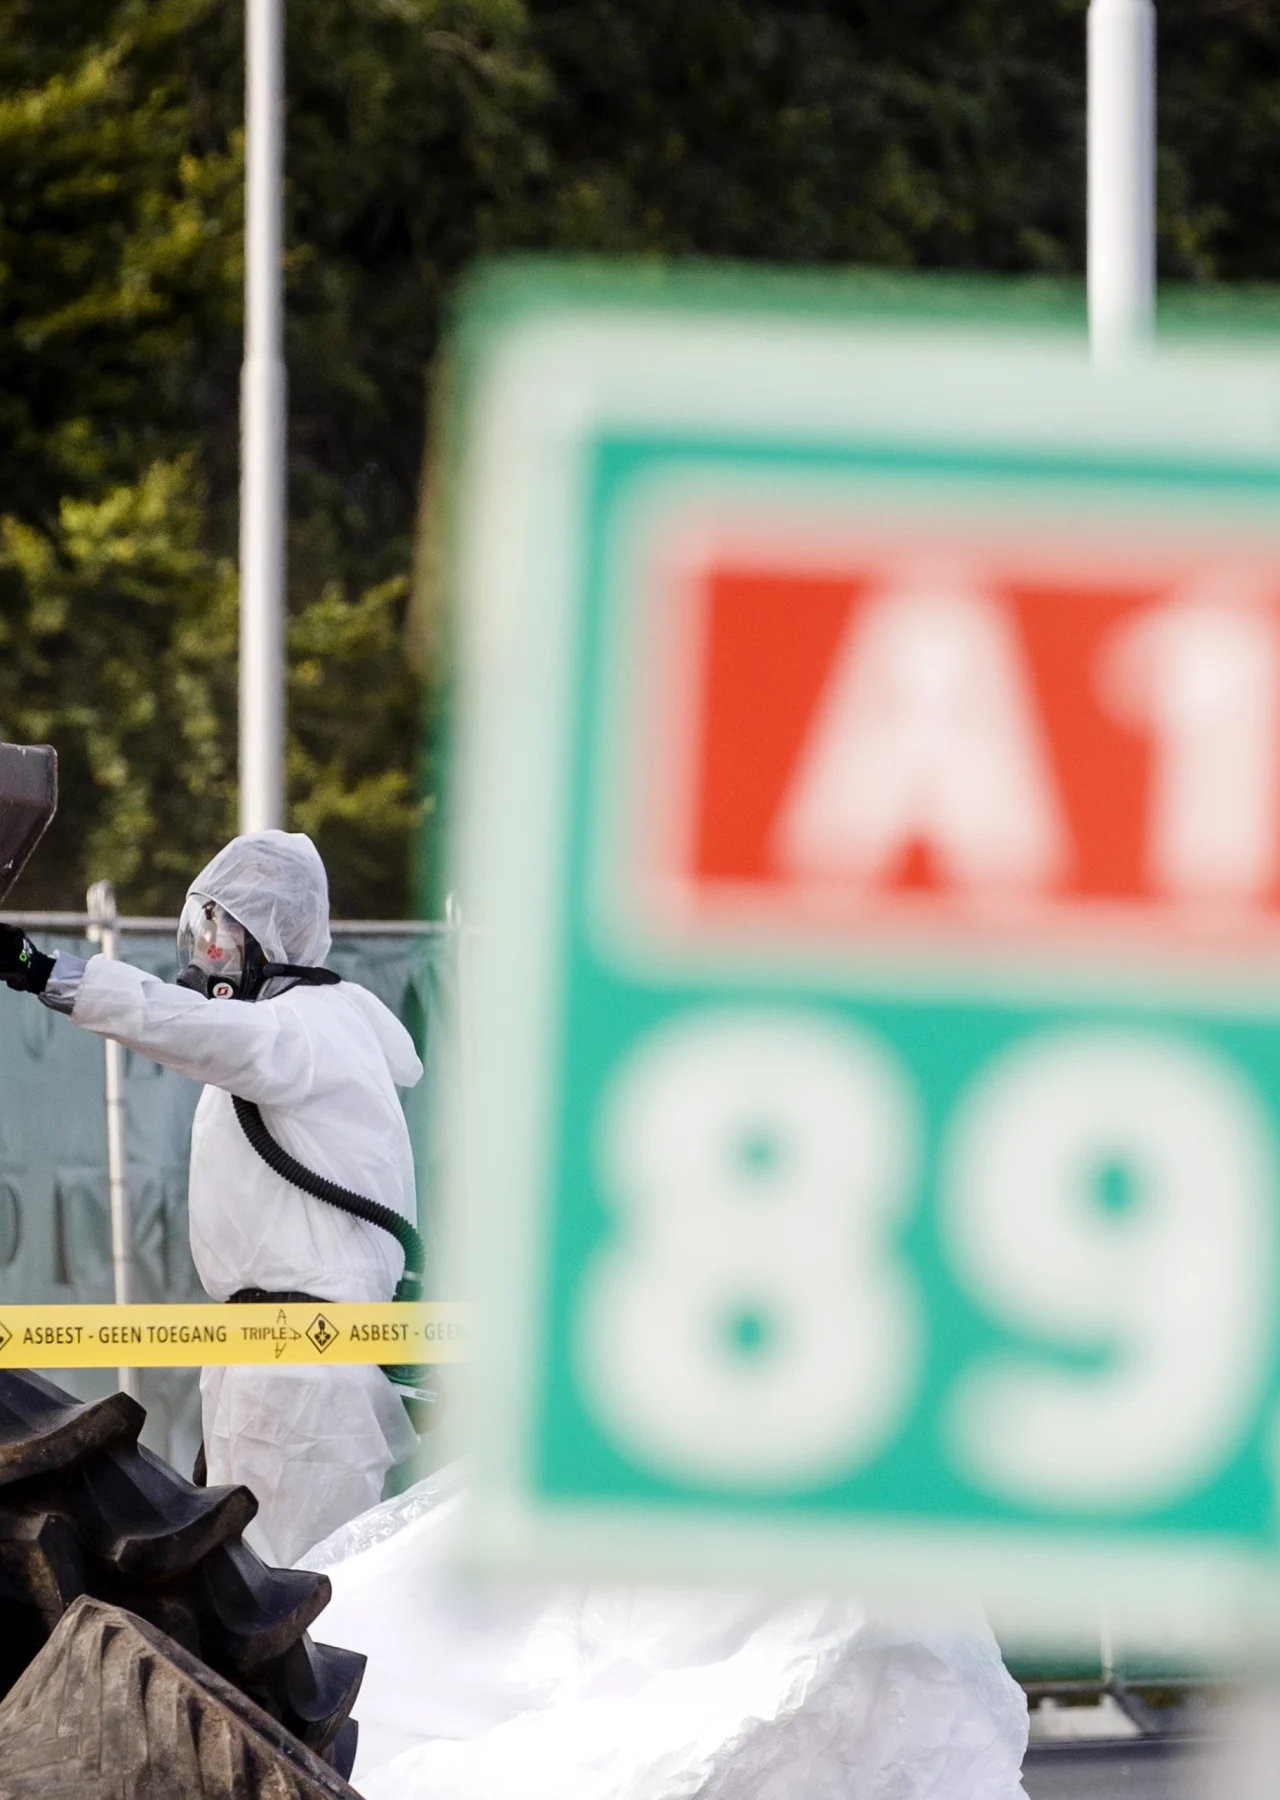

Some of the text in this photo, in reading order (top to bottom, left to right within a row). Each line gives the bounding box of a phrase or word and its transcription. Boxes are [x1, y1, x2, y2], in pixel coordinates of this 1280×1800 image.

[23, 1326, 84, 1345] ASBEST
[99, 1326, 142, 1344] GEEN
[147, 1325, 228, 1344] TOEGANG
[349, 1324, 410, 1342] ASBEST
